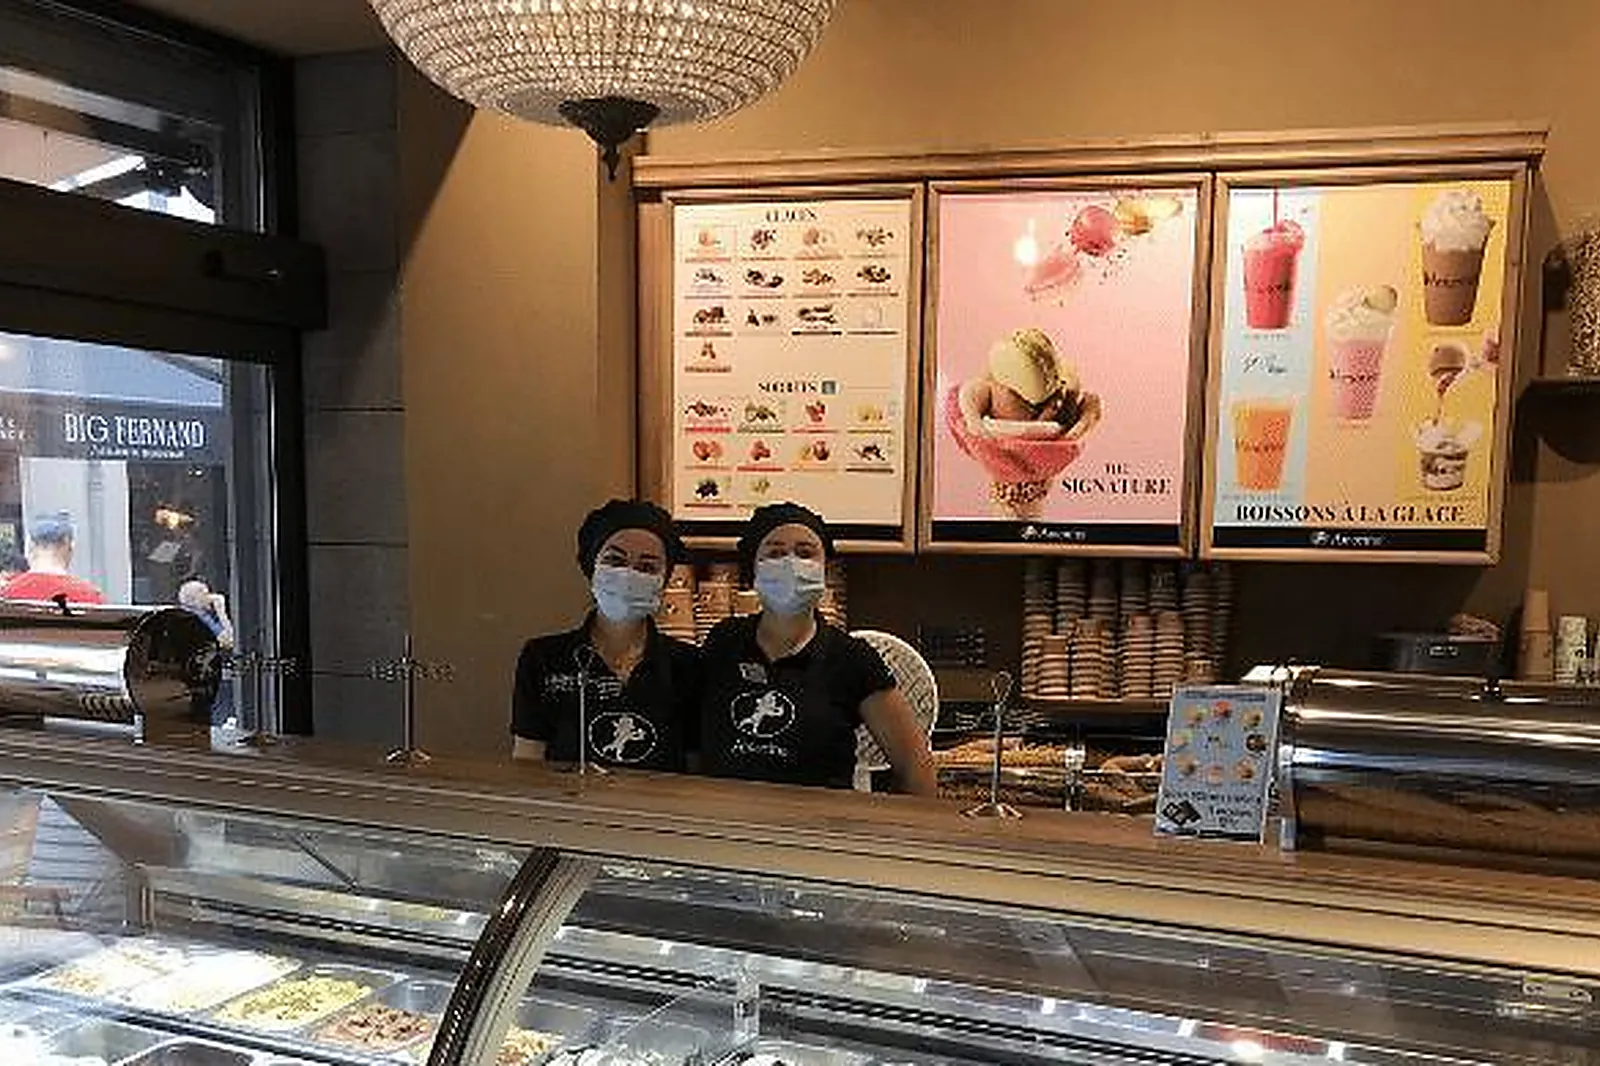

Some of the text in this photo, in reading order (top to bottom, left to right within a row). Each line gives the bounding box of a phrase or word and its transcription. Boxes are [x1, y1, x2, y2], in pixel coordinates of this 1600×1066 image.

[64, 413, 205, 448] BIG FERNAND
[1062, 478, 1172, 494] SIGNATURE
[1236, 505, 1335, 521] BOISSONS
[1393, 506, 1464, 522] GLACE
